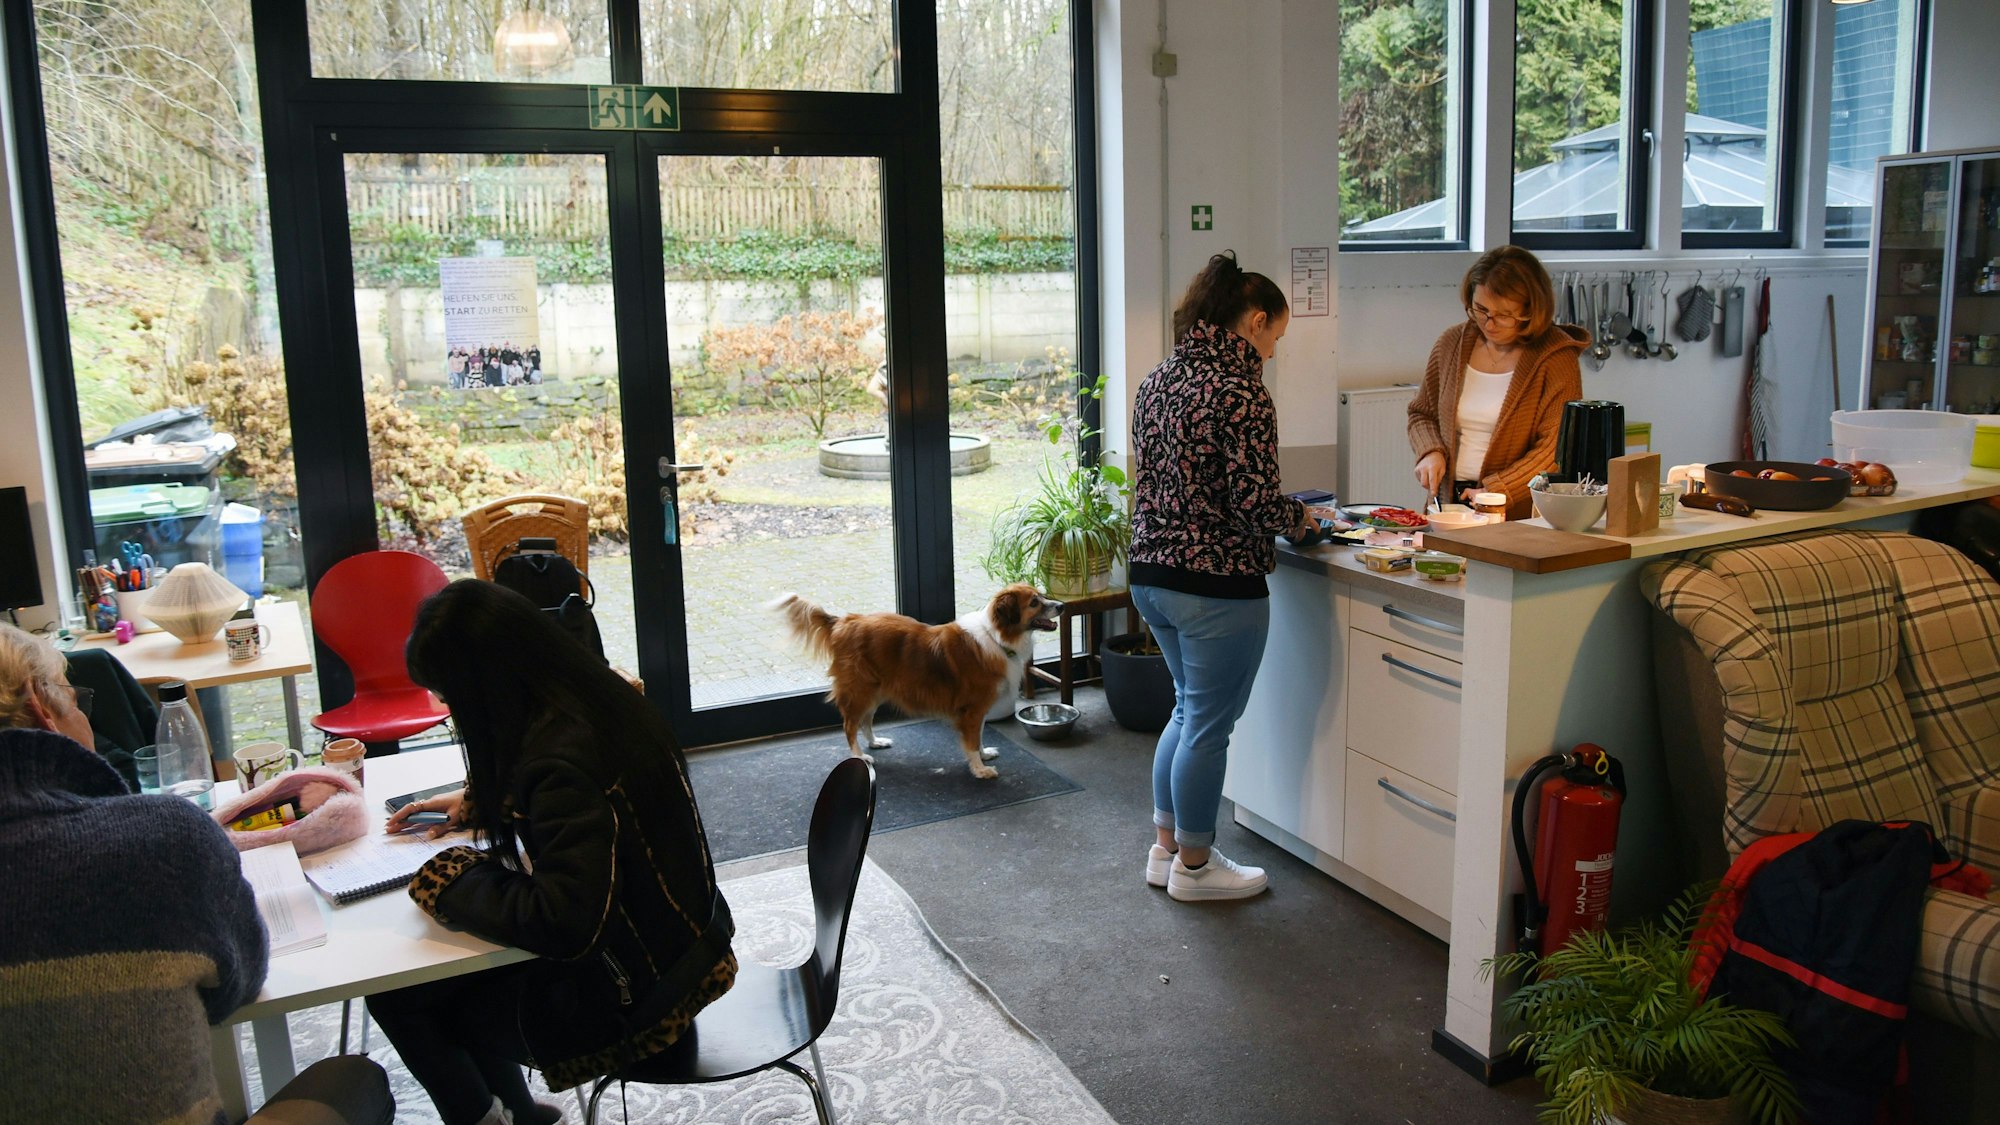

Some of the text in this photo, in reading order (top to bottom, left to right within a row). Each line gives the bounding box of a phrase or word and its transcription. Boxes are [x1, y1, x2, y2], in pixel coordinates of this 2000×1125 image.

[443, 294, 479, 303] HELFEN
[481, 293, 495, 302] SIE
[444, 305, 528, 316] START ZU RETTEN
[1580, 873, 1587, 887] 1
[1576, 887, 1587, 901] 2
[1575, 900, 1586, 915] 3
